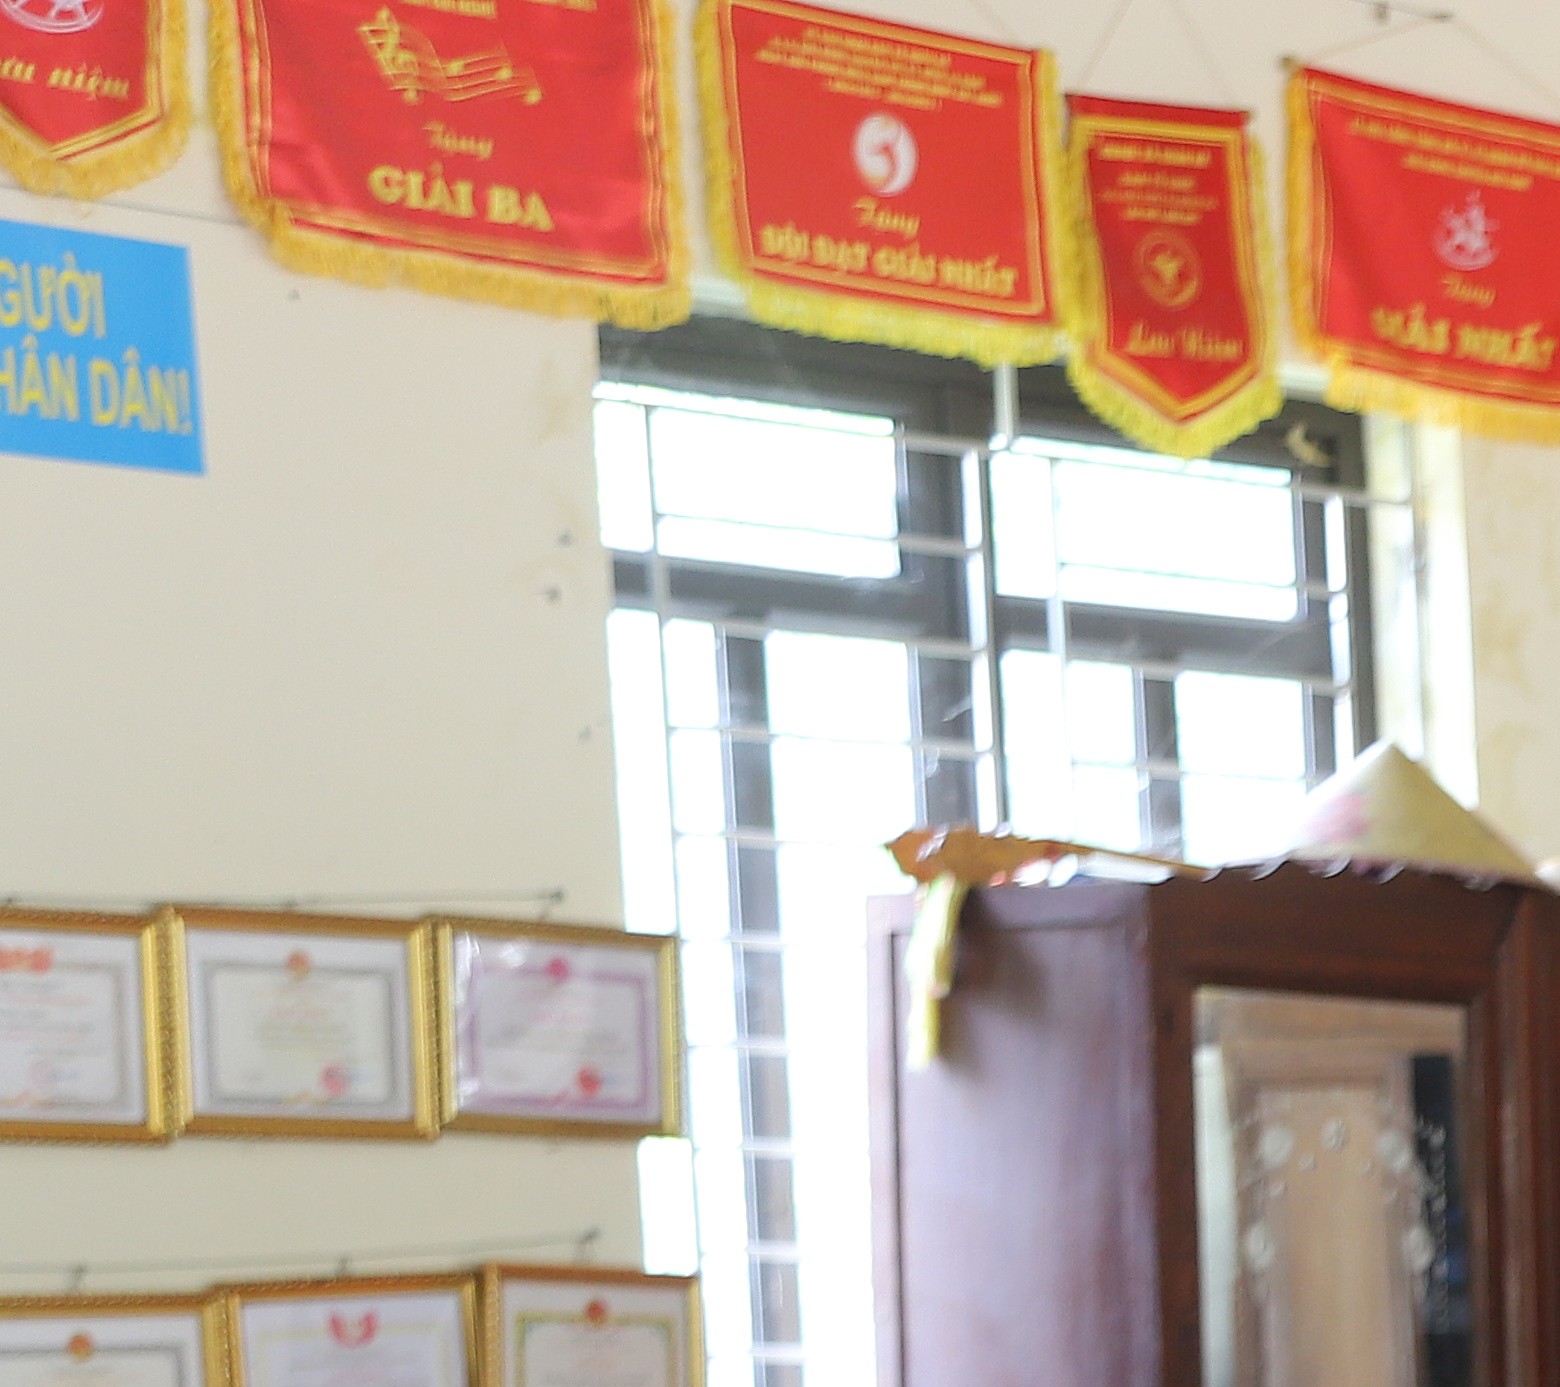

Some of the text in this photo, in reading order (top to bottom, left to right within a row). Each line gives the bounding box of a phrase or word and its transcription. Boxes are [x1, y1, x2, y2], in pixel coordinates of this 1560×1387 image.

[367, 160, 555, 233] GIẢI BA
[88, 346, 193, 436] DÂN!
